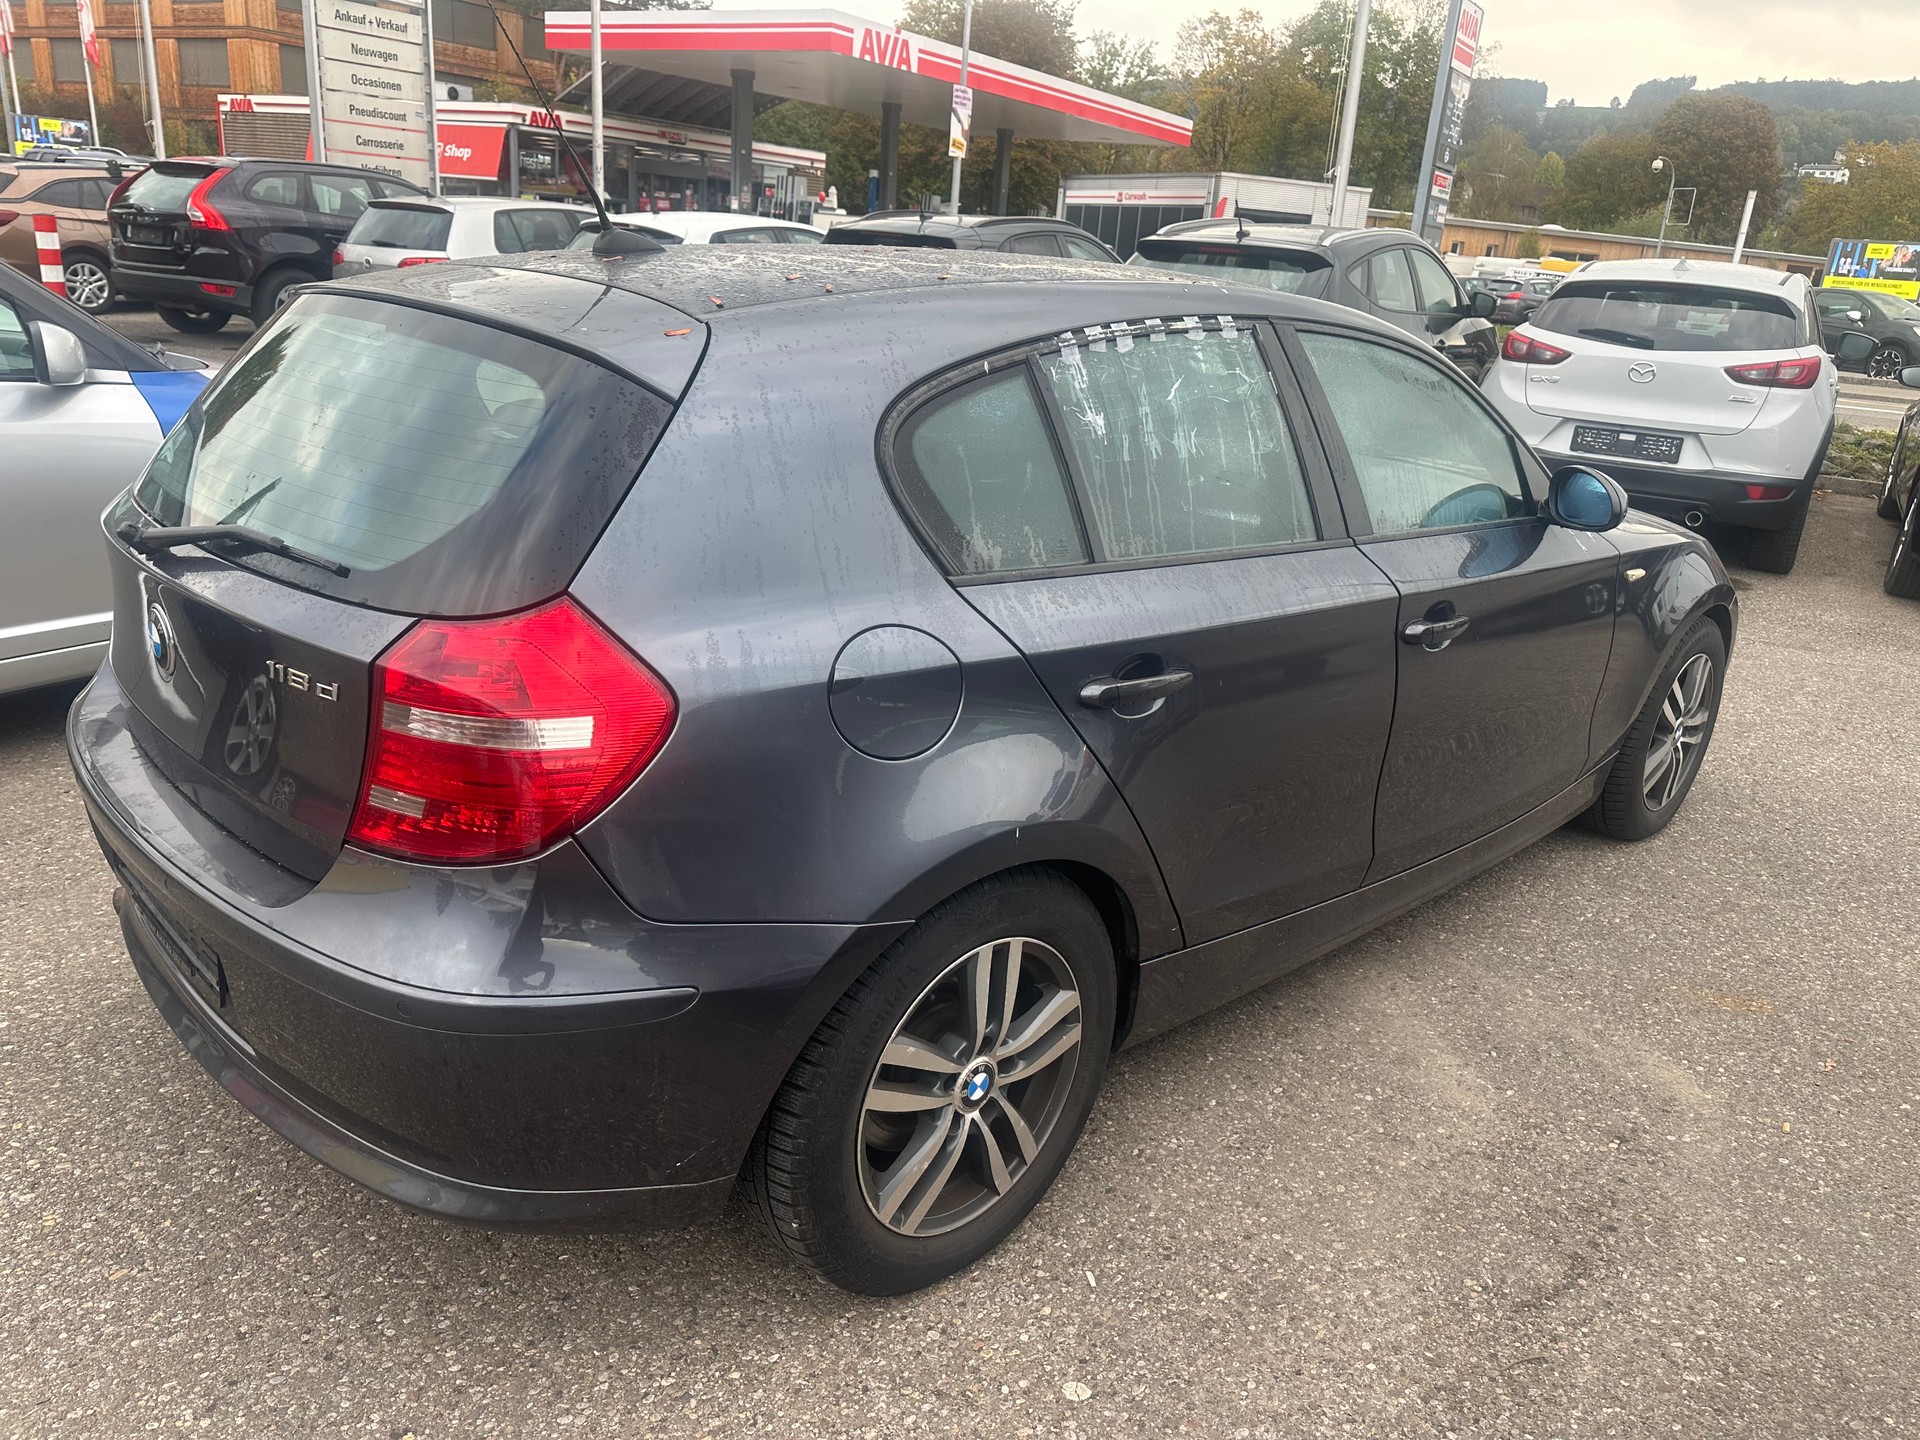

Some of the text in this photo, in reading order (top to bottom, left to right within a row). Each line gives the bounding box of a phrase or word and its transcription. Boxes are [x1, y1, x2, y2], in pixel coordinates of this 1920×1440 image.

[334, 9, 366, 25] Ankauf
[375, 16, 408, 33] Verkauf
[1458, 8, 1479, 42] AVIA
[351, 43, 398, 62] Neuwagen
[859, 27, 912, 72] AVIA
[351, 73, 402, 91] Occasionen
[230, 95, 254, 112] AVIA
[349, 104, 407, 122] Pneudiscount
[529, 110, 563, 130] AVIA
[355, 135, 404, 151] Carrosserie
[443, 144, 472, 161] Shop
[1124, 192, 1147, 201] Carwash
